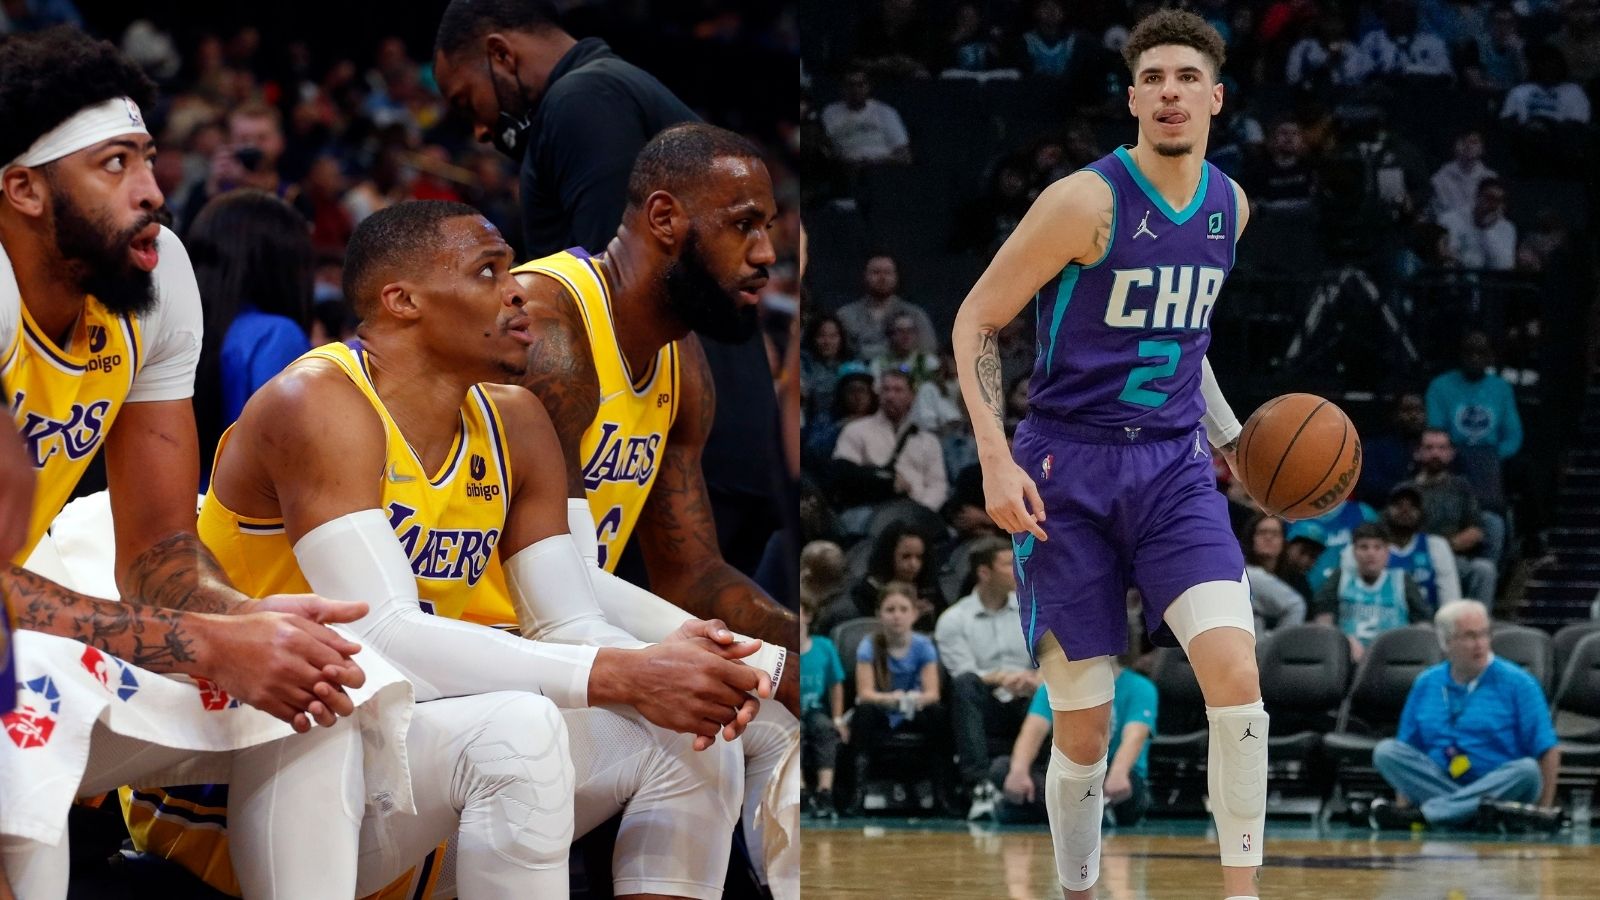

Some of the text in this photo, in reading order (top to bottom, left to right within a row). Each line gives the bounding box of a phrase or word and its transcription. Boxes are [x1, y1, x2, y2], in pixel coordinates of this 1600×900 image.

[1104, 265, 1225, 329] CHA
[1118, 340, 1182, 408] 2
[466, 483, 500, 501] bibigo
